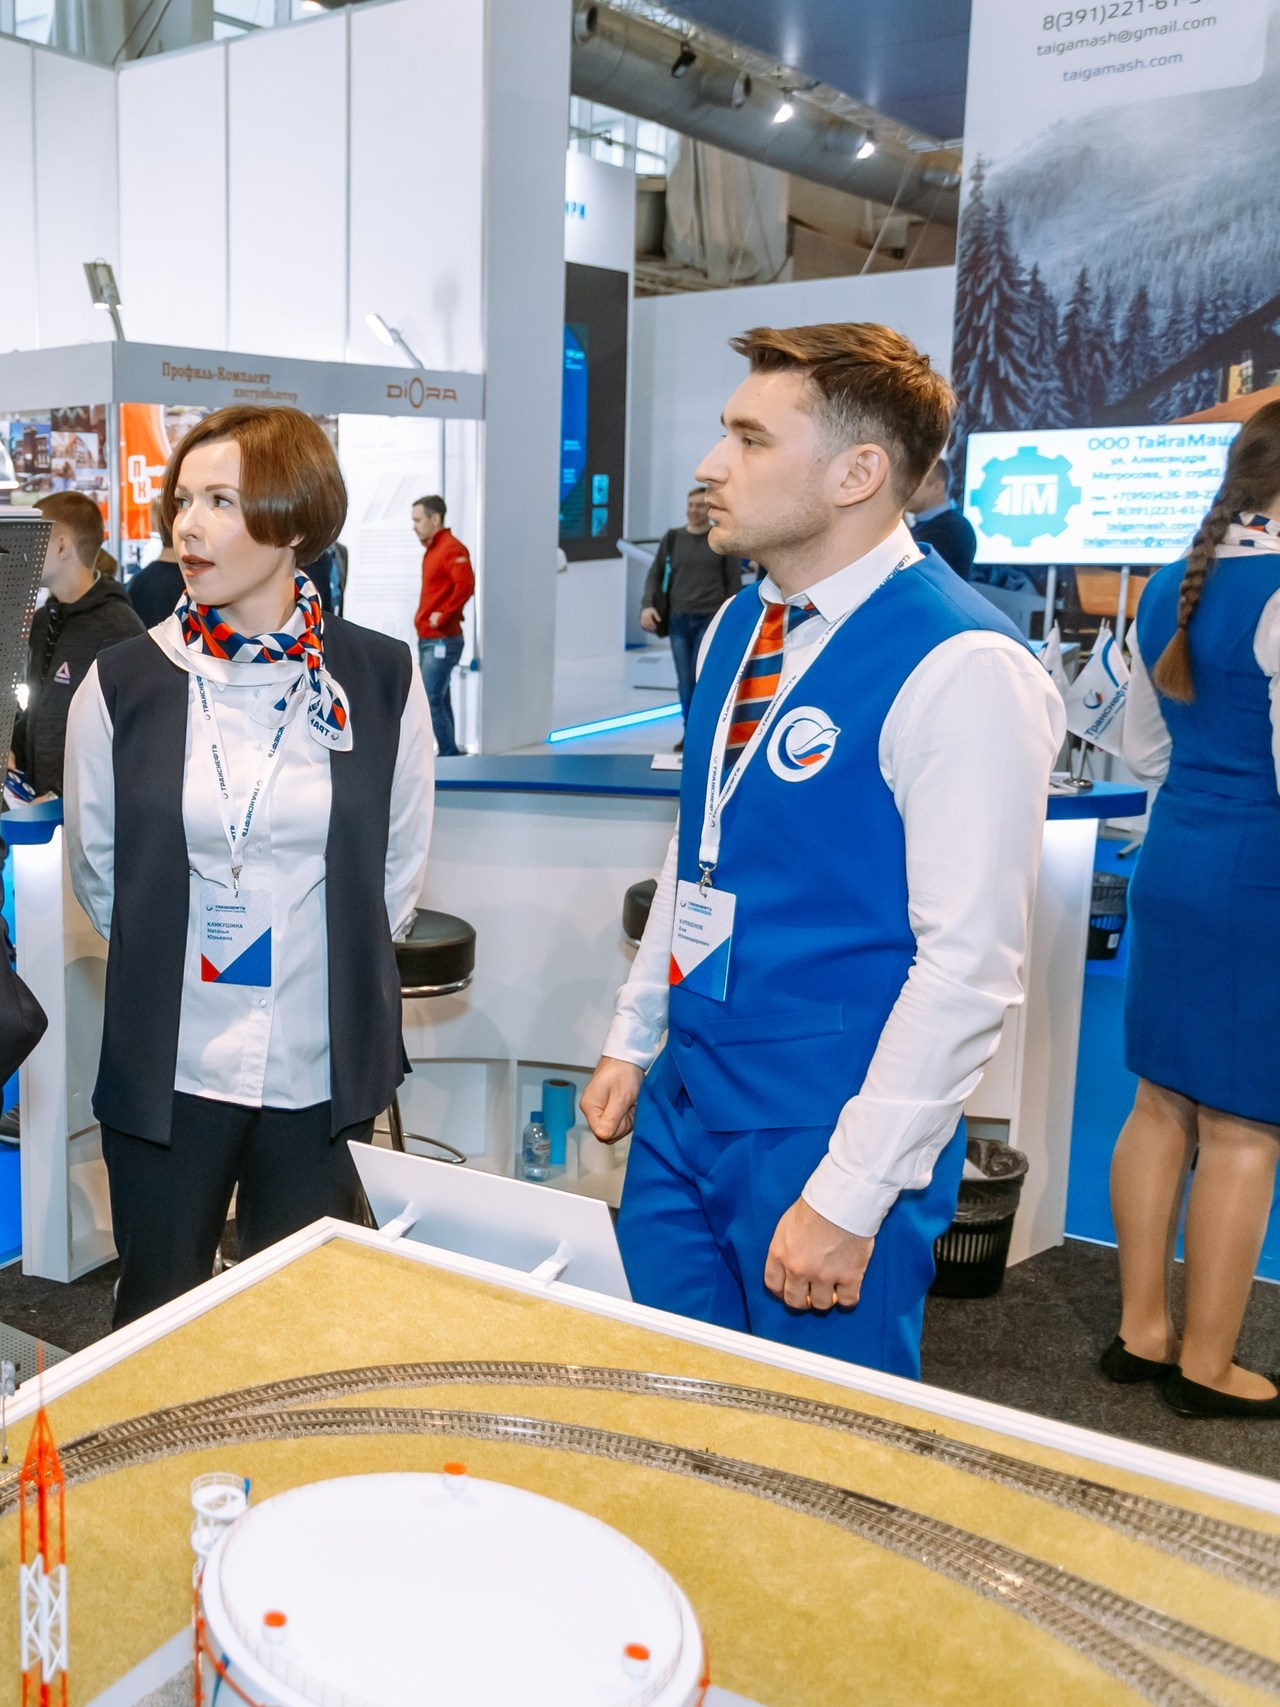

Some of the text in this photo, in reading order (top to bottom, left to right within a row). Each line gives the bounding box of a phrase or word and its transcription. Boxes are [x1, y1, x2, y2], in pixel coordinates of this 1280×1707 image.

[1042, 0, 1202, 32] 8(391)221-6-
[1037, 16, 1217, 56] taigamash@gmail.com
[1062, 53, 1184, 82] taigamash.com
[161, 361, 272, 385] Профиль-Комплект
[1088, 436, 1130, 450] ООО
[196, 675, 209, 713] ТРАНСНЕФ
[1084, 680, 1130, 737] Транснефт
[267, 726, 285, 759] СНЕФТЬ
[211, 743, 227, 792] ТРАНСНЕФТЬ
[241, 786, 261, 838] ТРАНСНЕФТЬ
